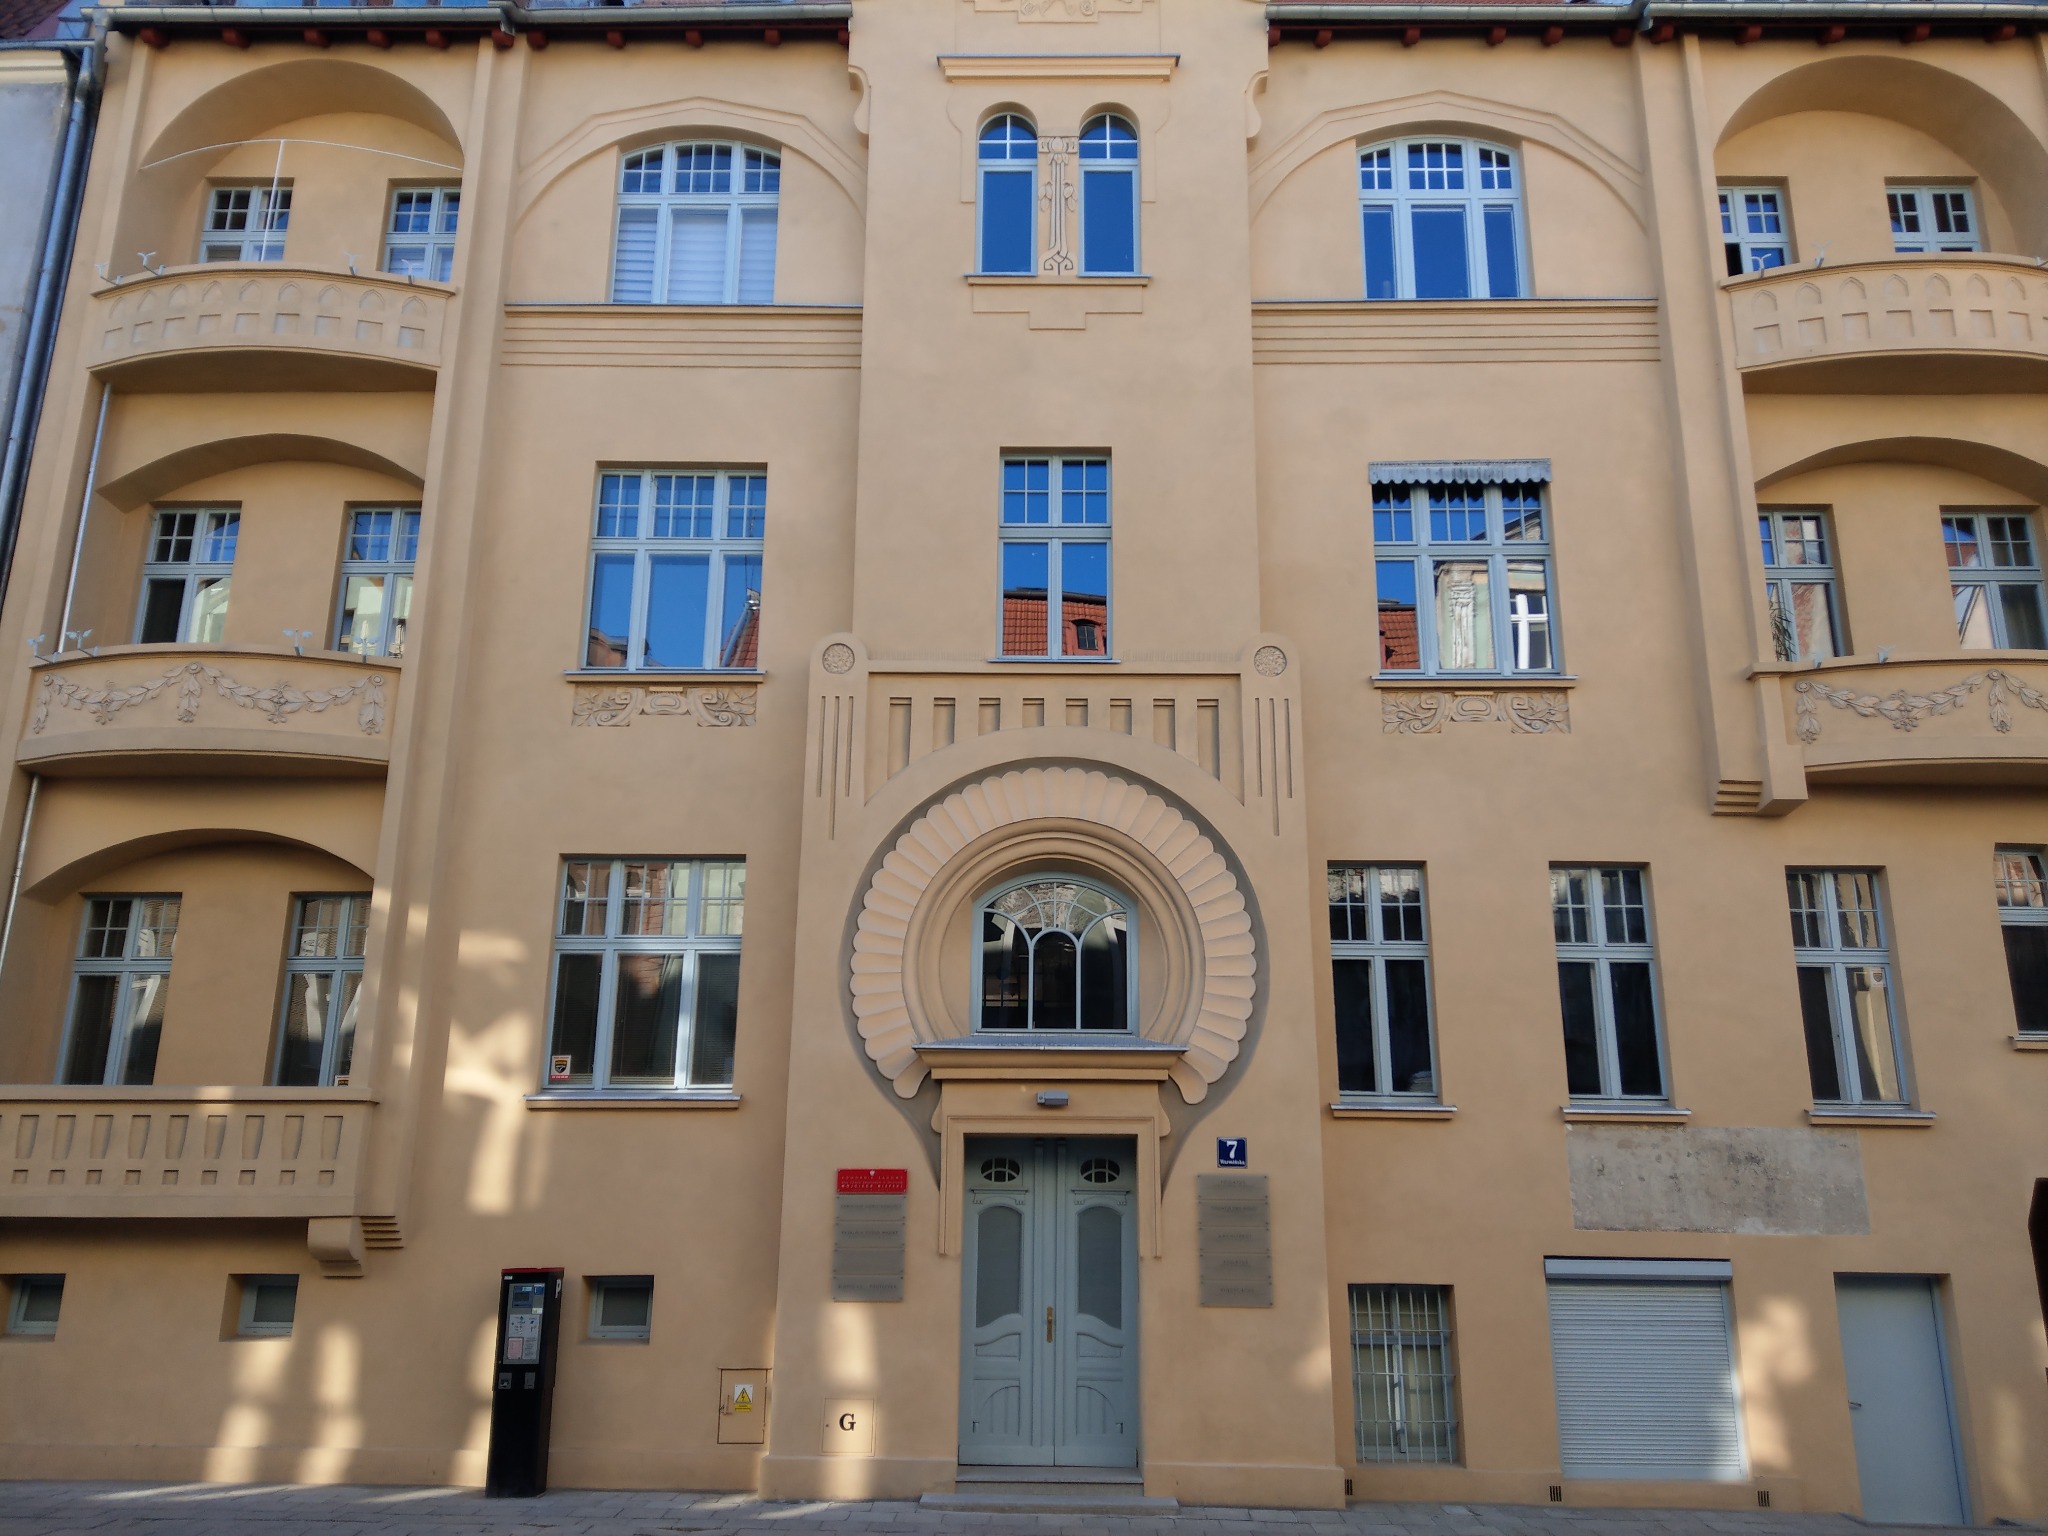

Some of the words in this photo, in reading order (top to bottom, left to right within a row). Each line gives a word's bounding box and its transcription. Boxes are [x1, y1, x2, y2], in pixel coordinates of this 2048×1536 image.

[1226, 1140, 1238, 1159] 7
[555, 1279, 562, 1299] P
[839, 1413, 856, 1431] G
